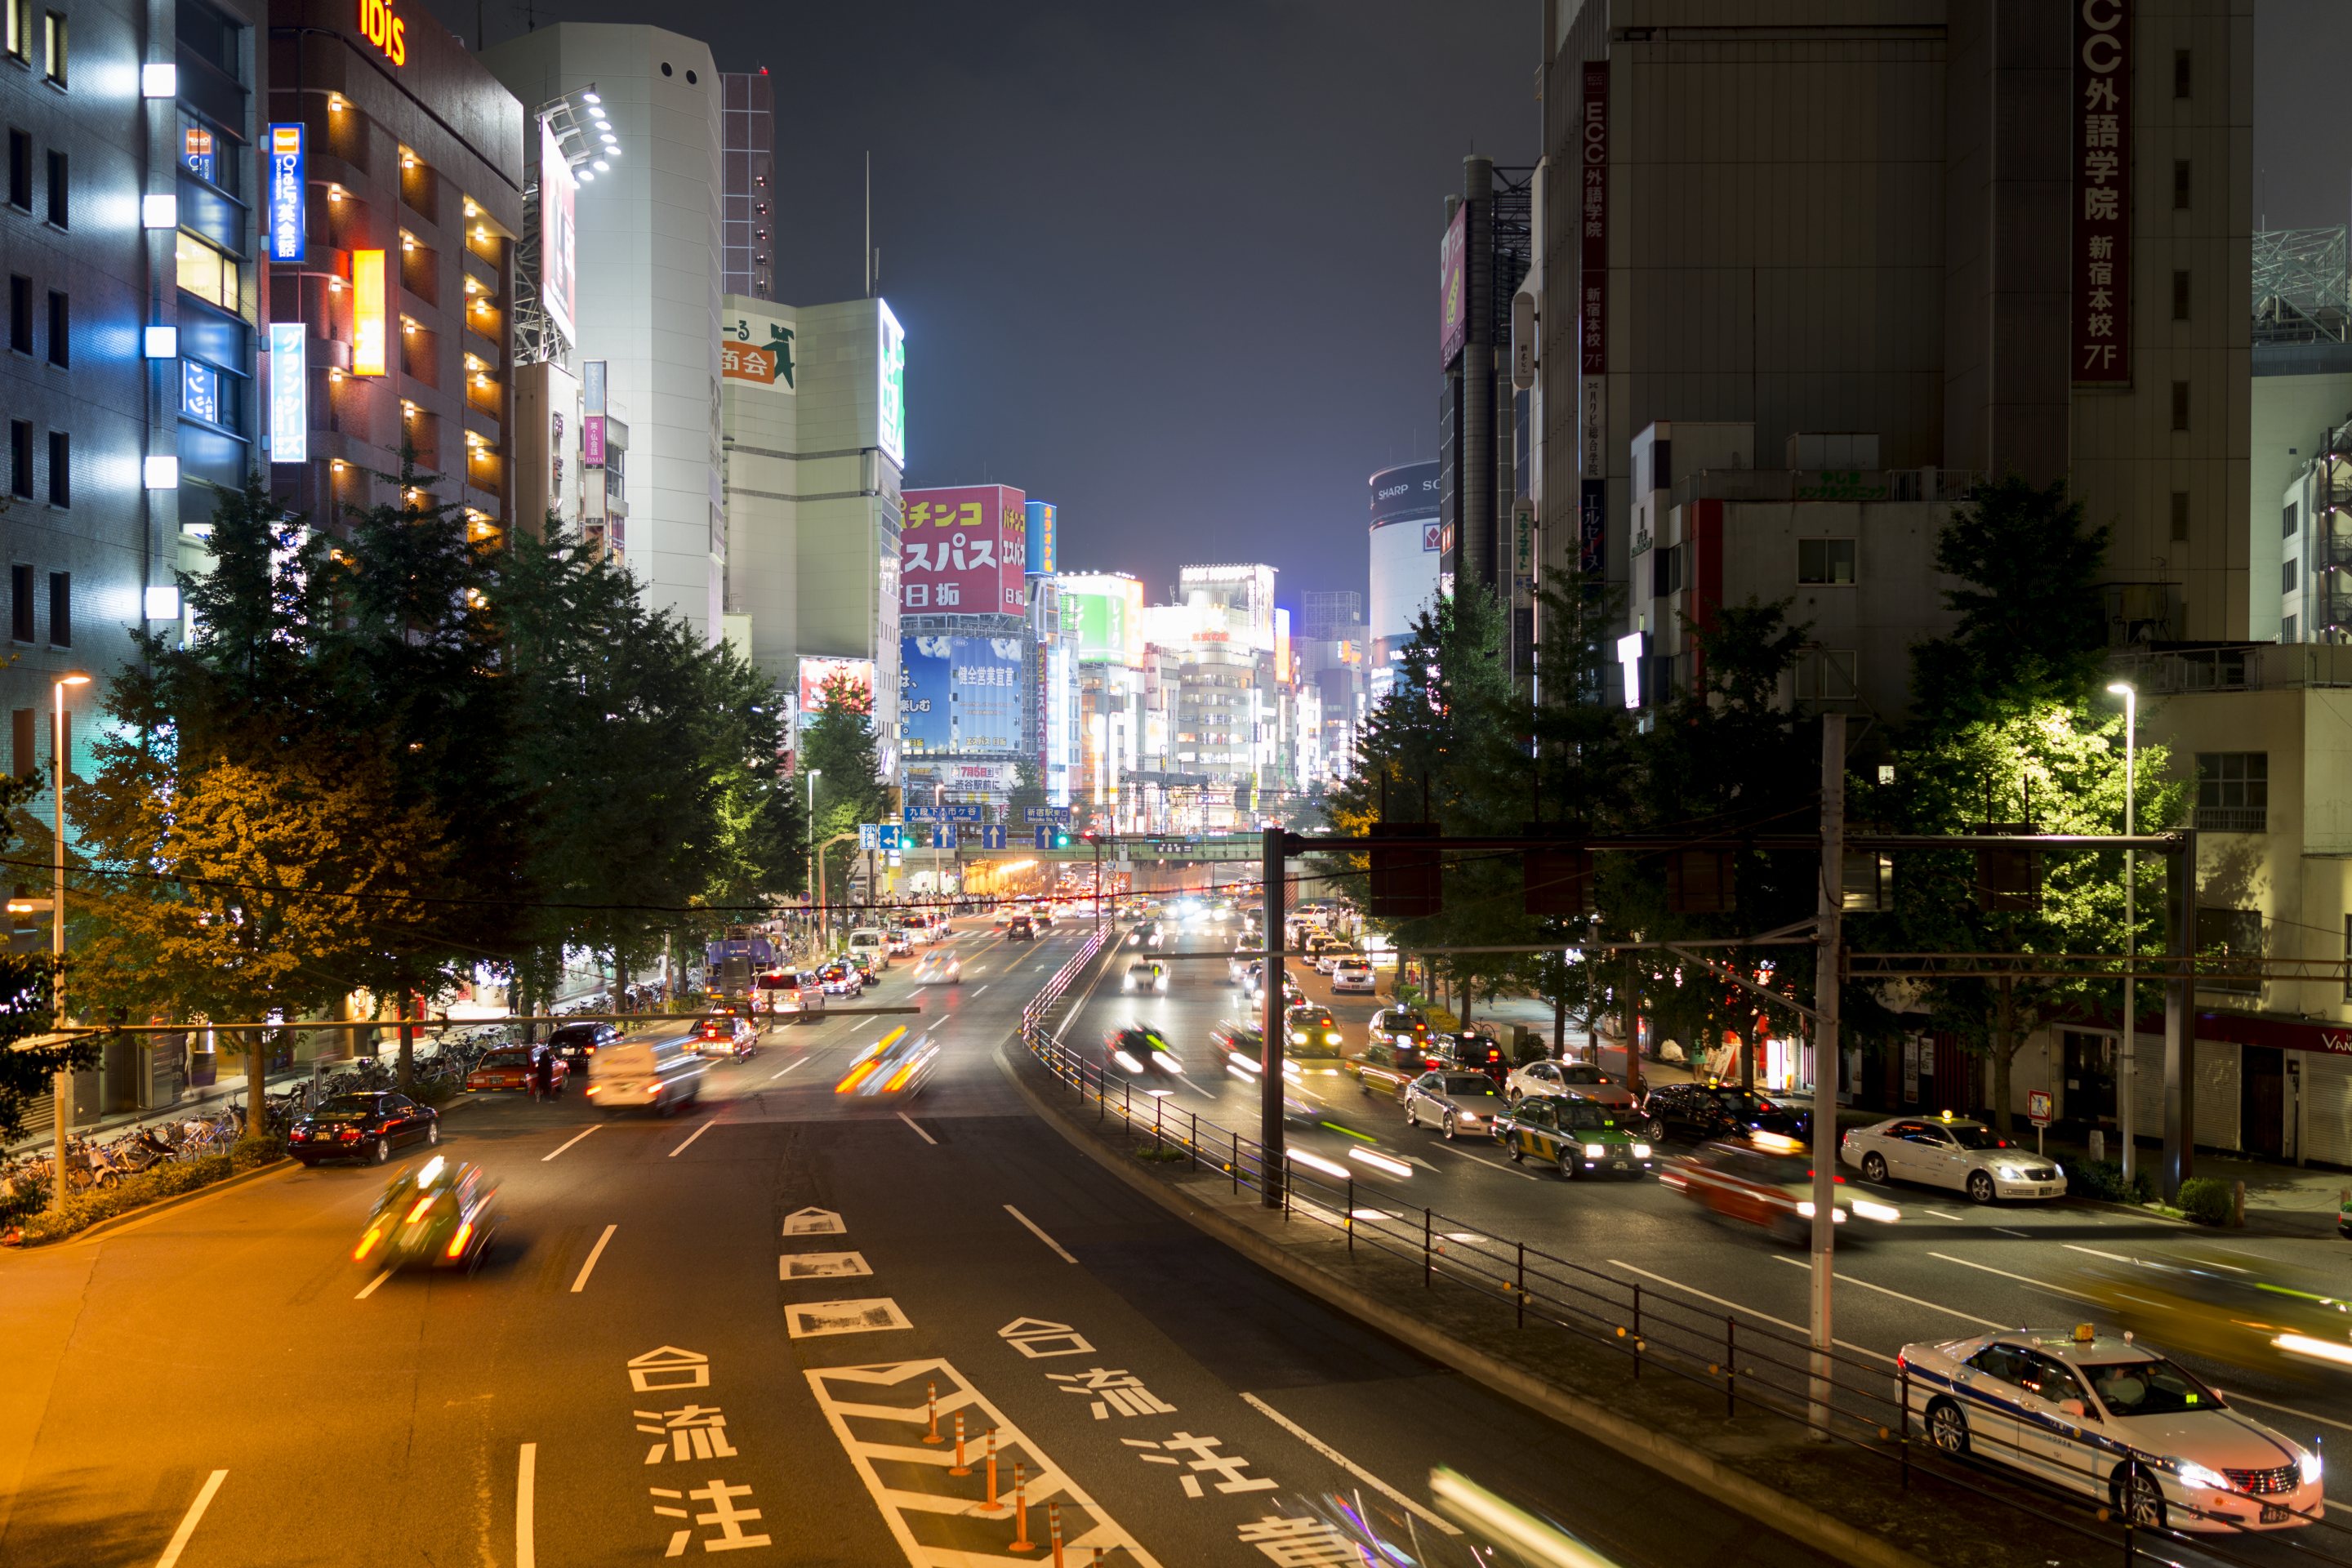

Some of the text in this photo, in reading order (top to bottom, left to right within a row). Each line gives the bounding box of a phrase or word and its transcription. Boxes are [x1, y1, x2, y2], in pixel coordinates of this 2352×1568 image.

[2088, 235, 2114, 337] 新宿本校
[1586, 287, 1601, 347] 新宿本校
[1584, 354, 1602, 368] 7F
[2084, 345, 2117, 369] 7F
[1588, 392, 1598, 476] ハクビ総合学院
[1379, 484, 1409, 500] SHARP
[1004, 505, 1025, 532] パチンコ
[1584, 494, 1600, 570] エルセーヌ
[1003, 536, 1025, 566] エスパス
[1112, 599, 1120, 648] レイク
[958, 666, 1014, 687] 健全営業宣言
[955, 779, 1000, 791] 渋谷駅前に
[910, 808, 938, 816] 九段下
[1027, 808, 1067, 817] 新宿駅東口
[627, 1345, 772, 1557] 合流注
